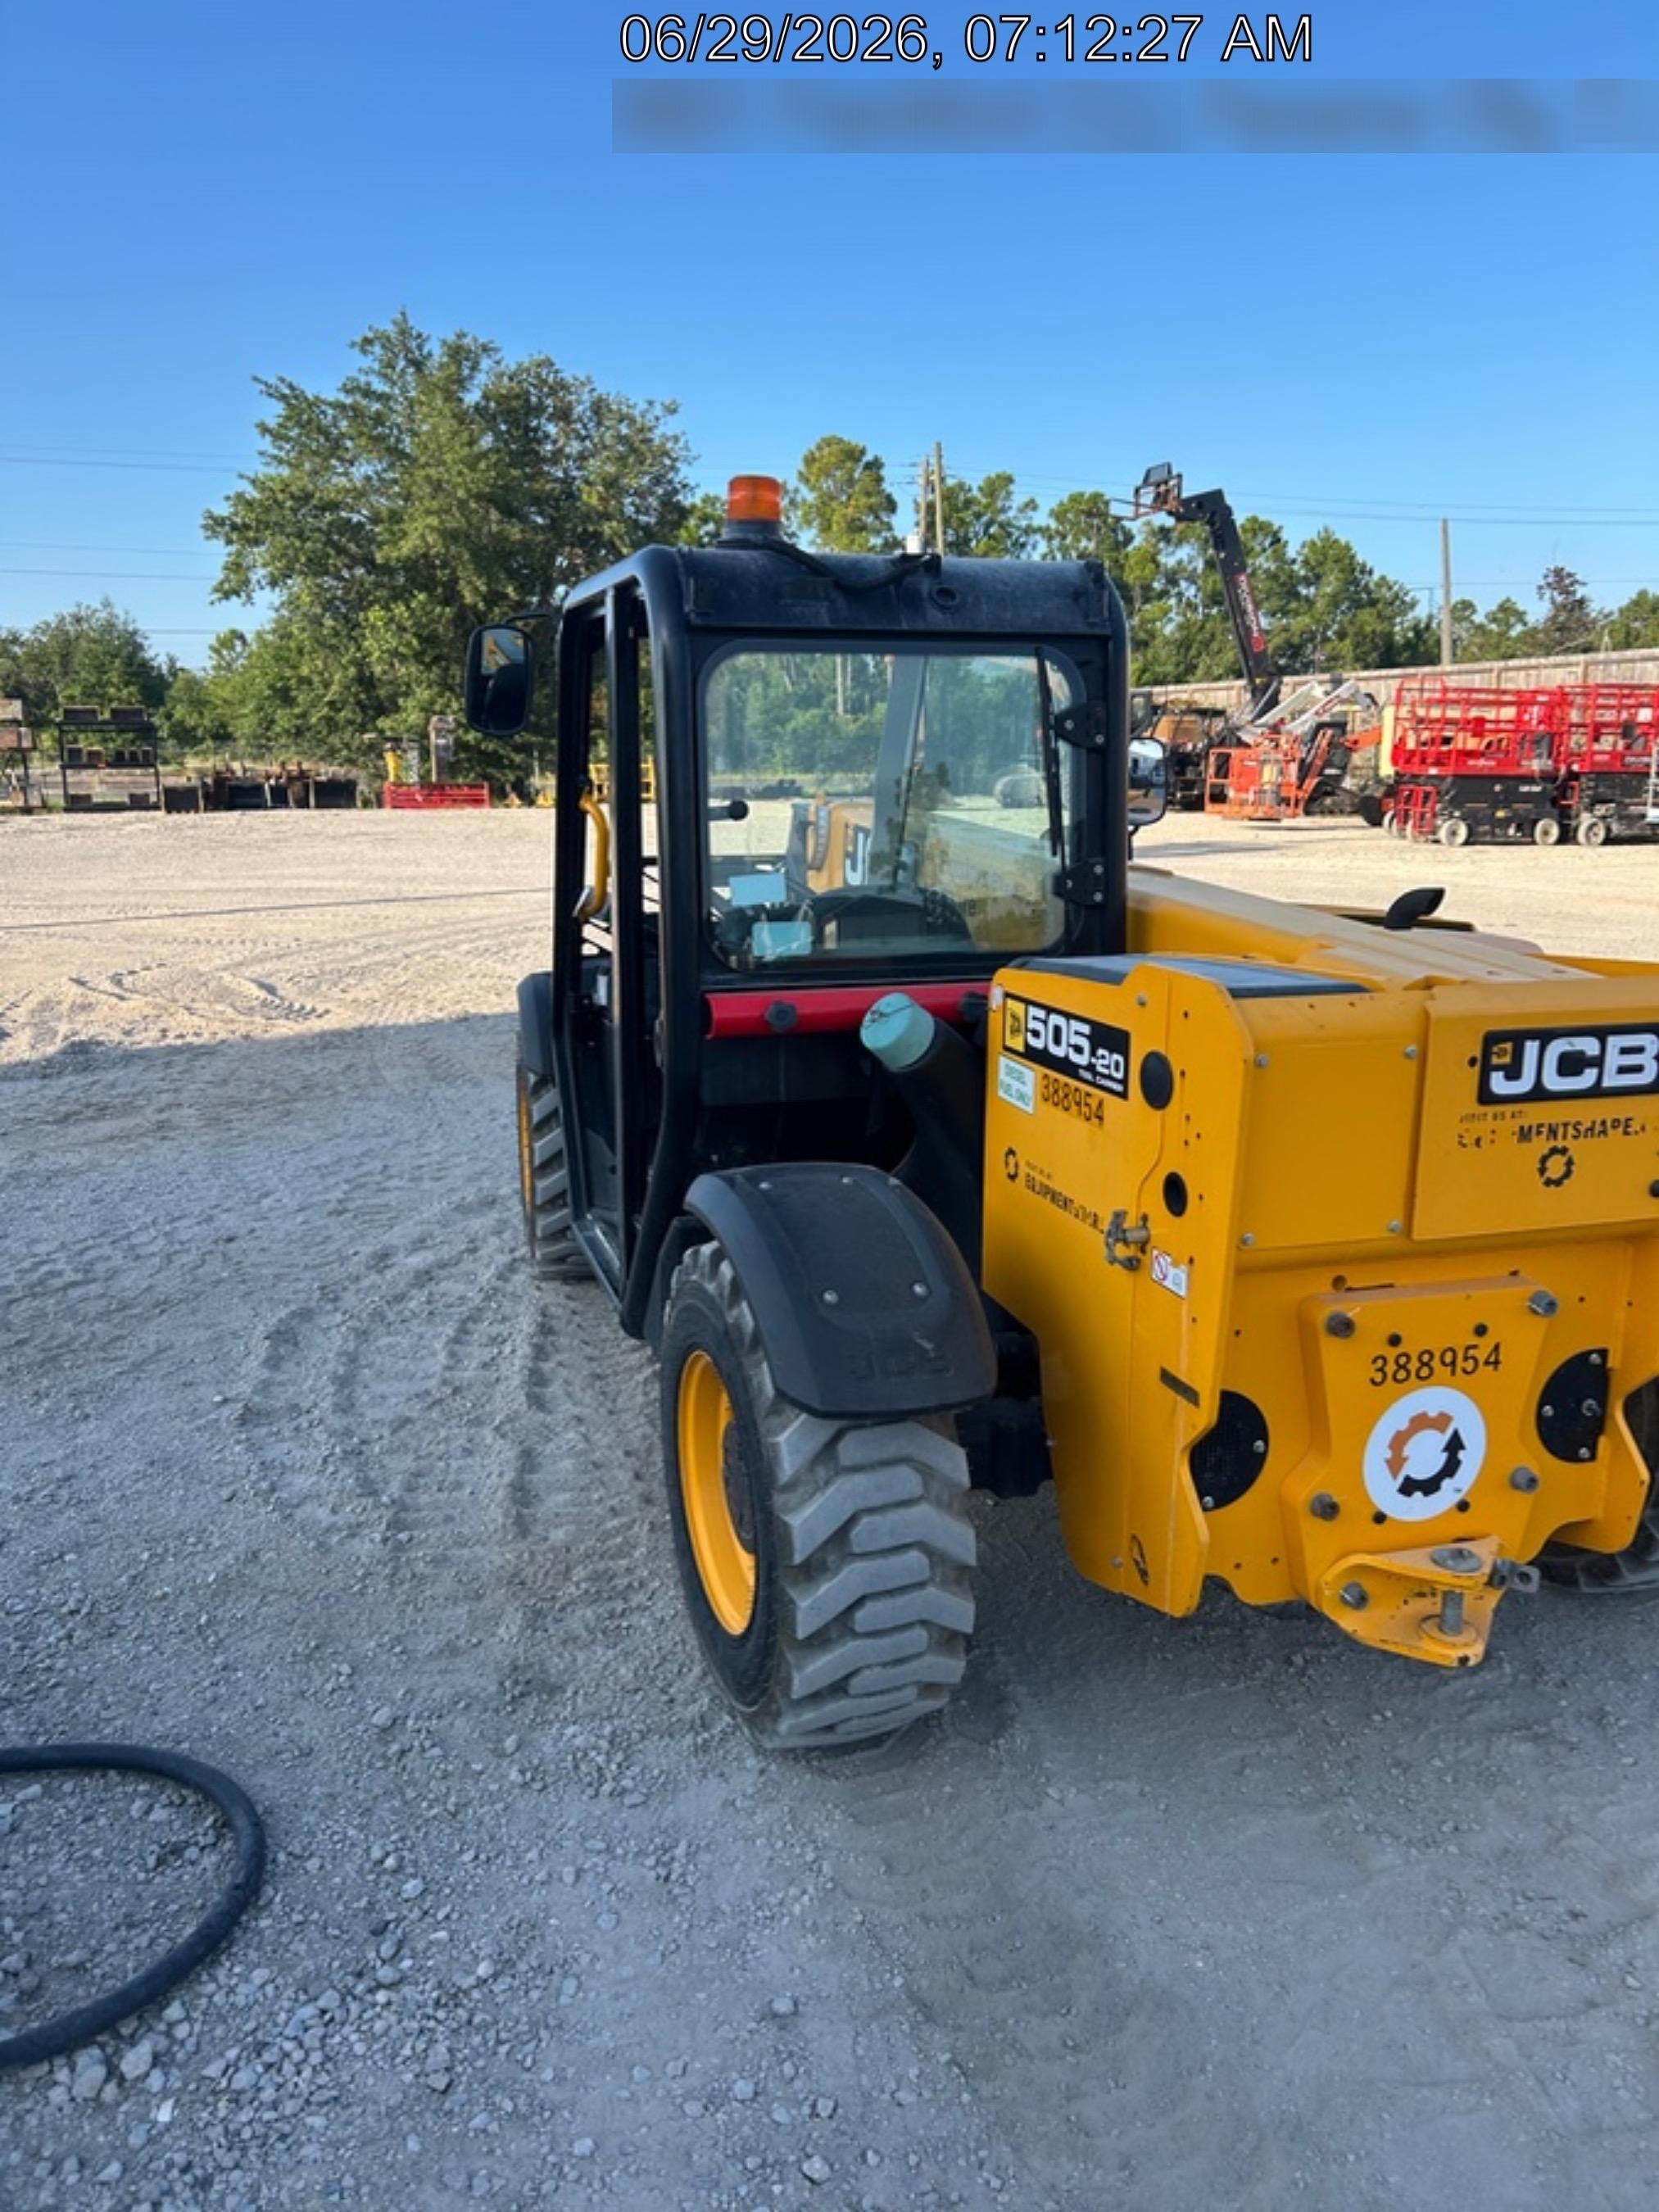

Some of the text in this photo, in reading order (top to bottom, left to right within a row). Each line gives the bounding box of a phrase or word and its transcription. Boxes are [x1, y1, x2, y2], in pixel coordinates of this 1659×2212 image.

[1027, 1004, 1124, 1080] 505-20
[1489, 1032, 1659, 1095] JCB
[1041, 1073, 1104, 1126] 388954
[1369, 1342, 1502, 1387] 388954
